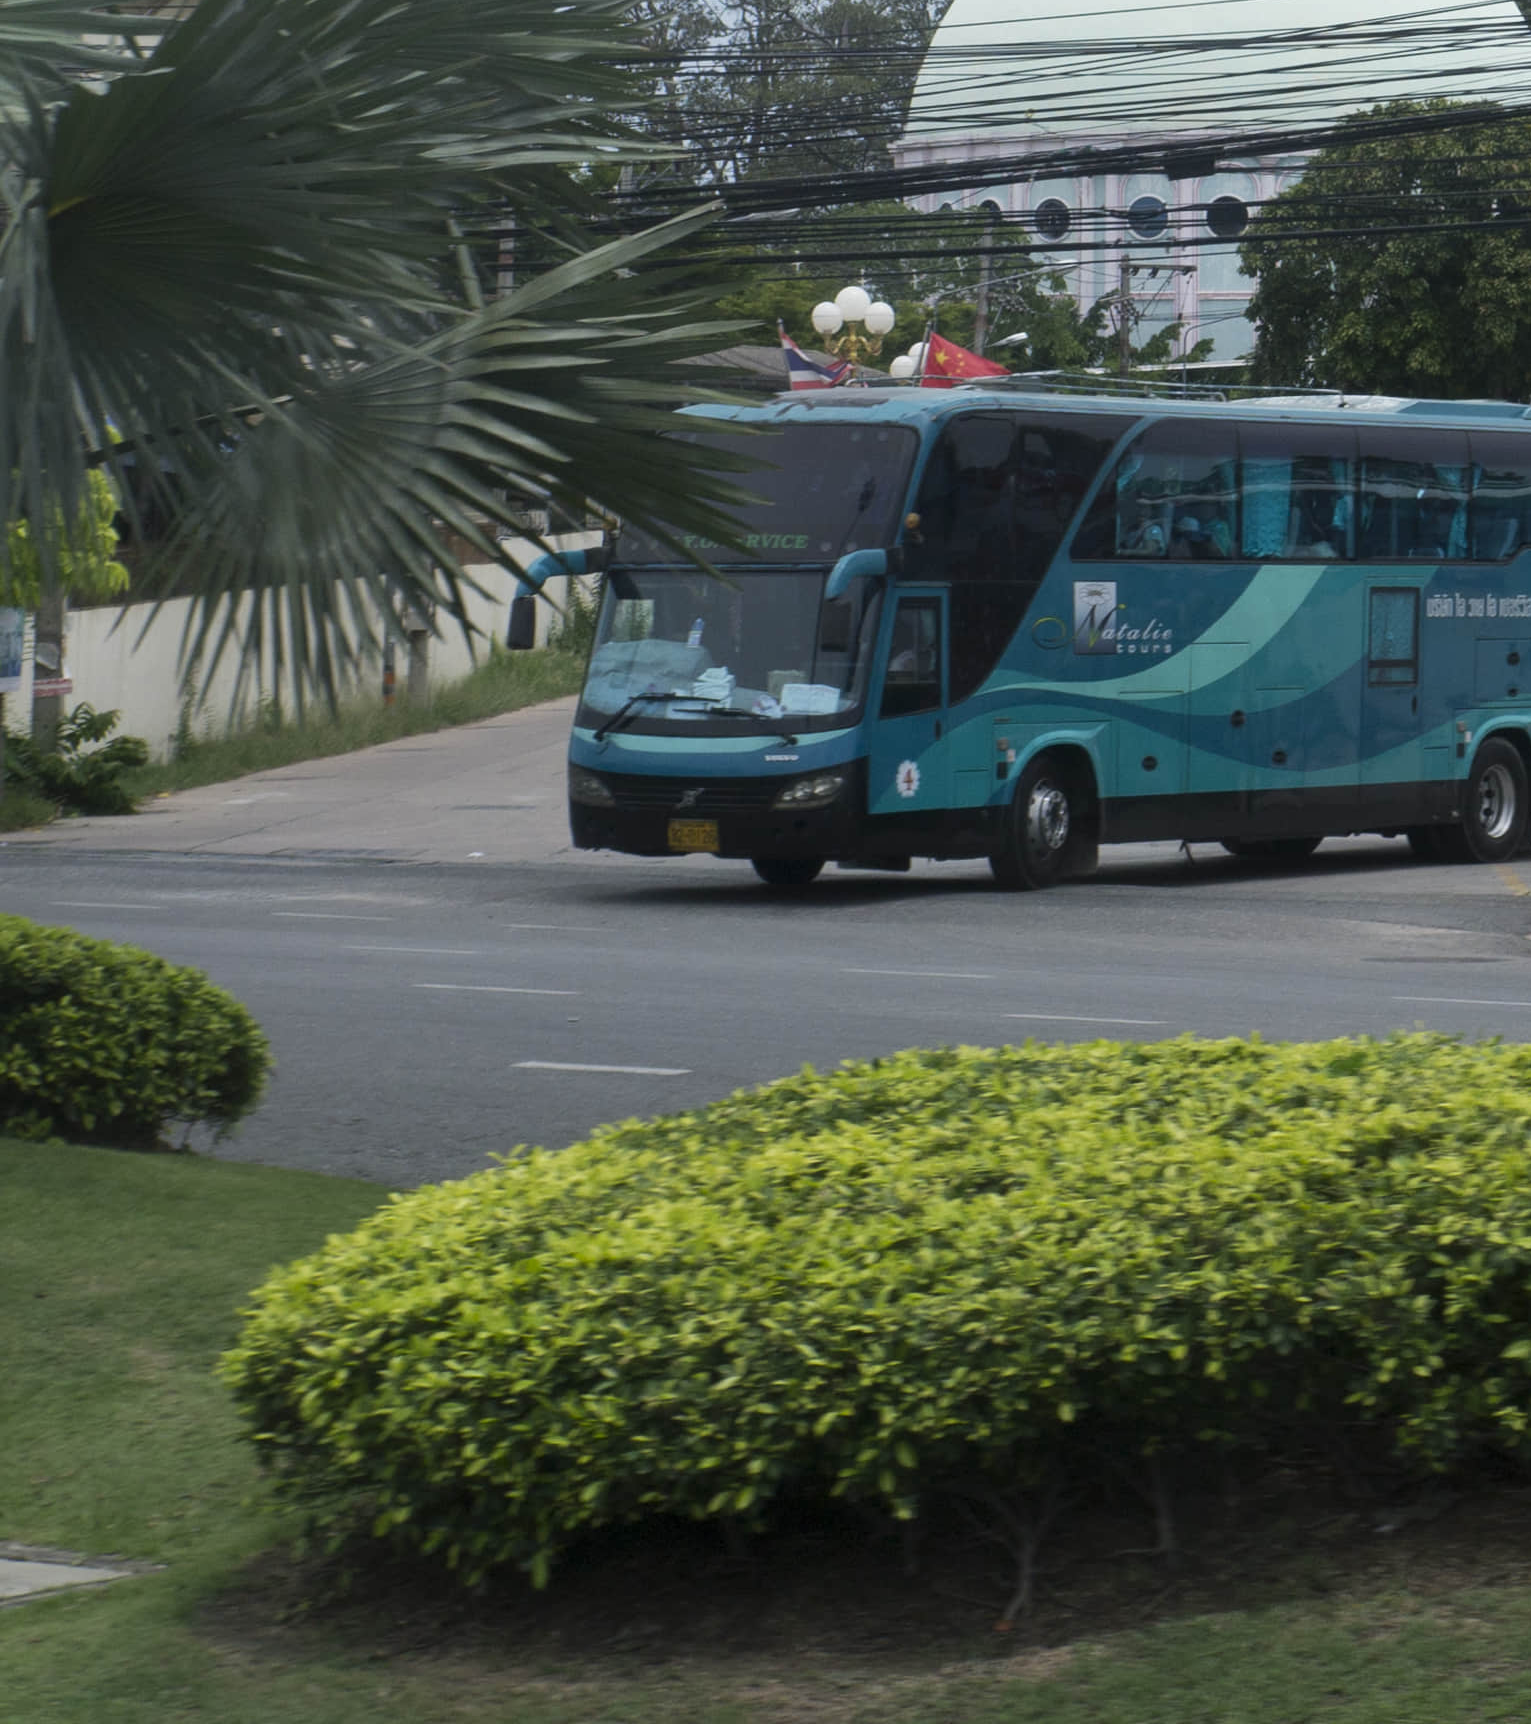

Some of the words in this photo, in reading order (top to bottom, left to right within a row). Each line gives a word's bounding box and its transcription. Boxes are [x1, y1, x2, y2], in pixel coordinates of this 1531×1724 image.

[1072, 603, 1174, 647] Natalie
[1116, 643, 1172, 653] tours
[903, 768, 914, 791] 4
